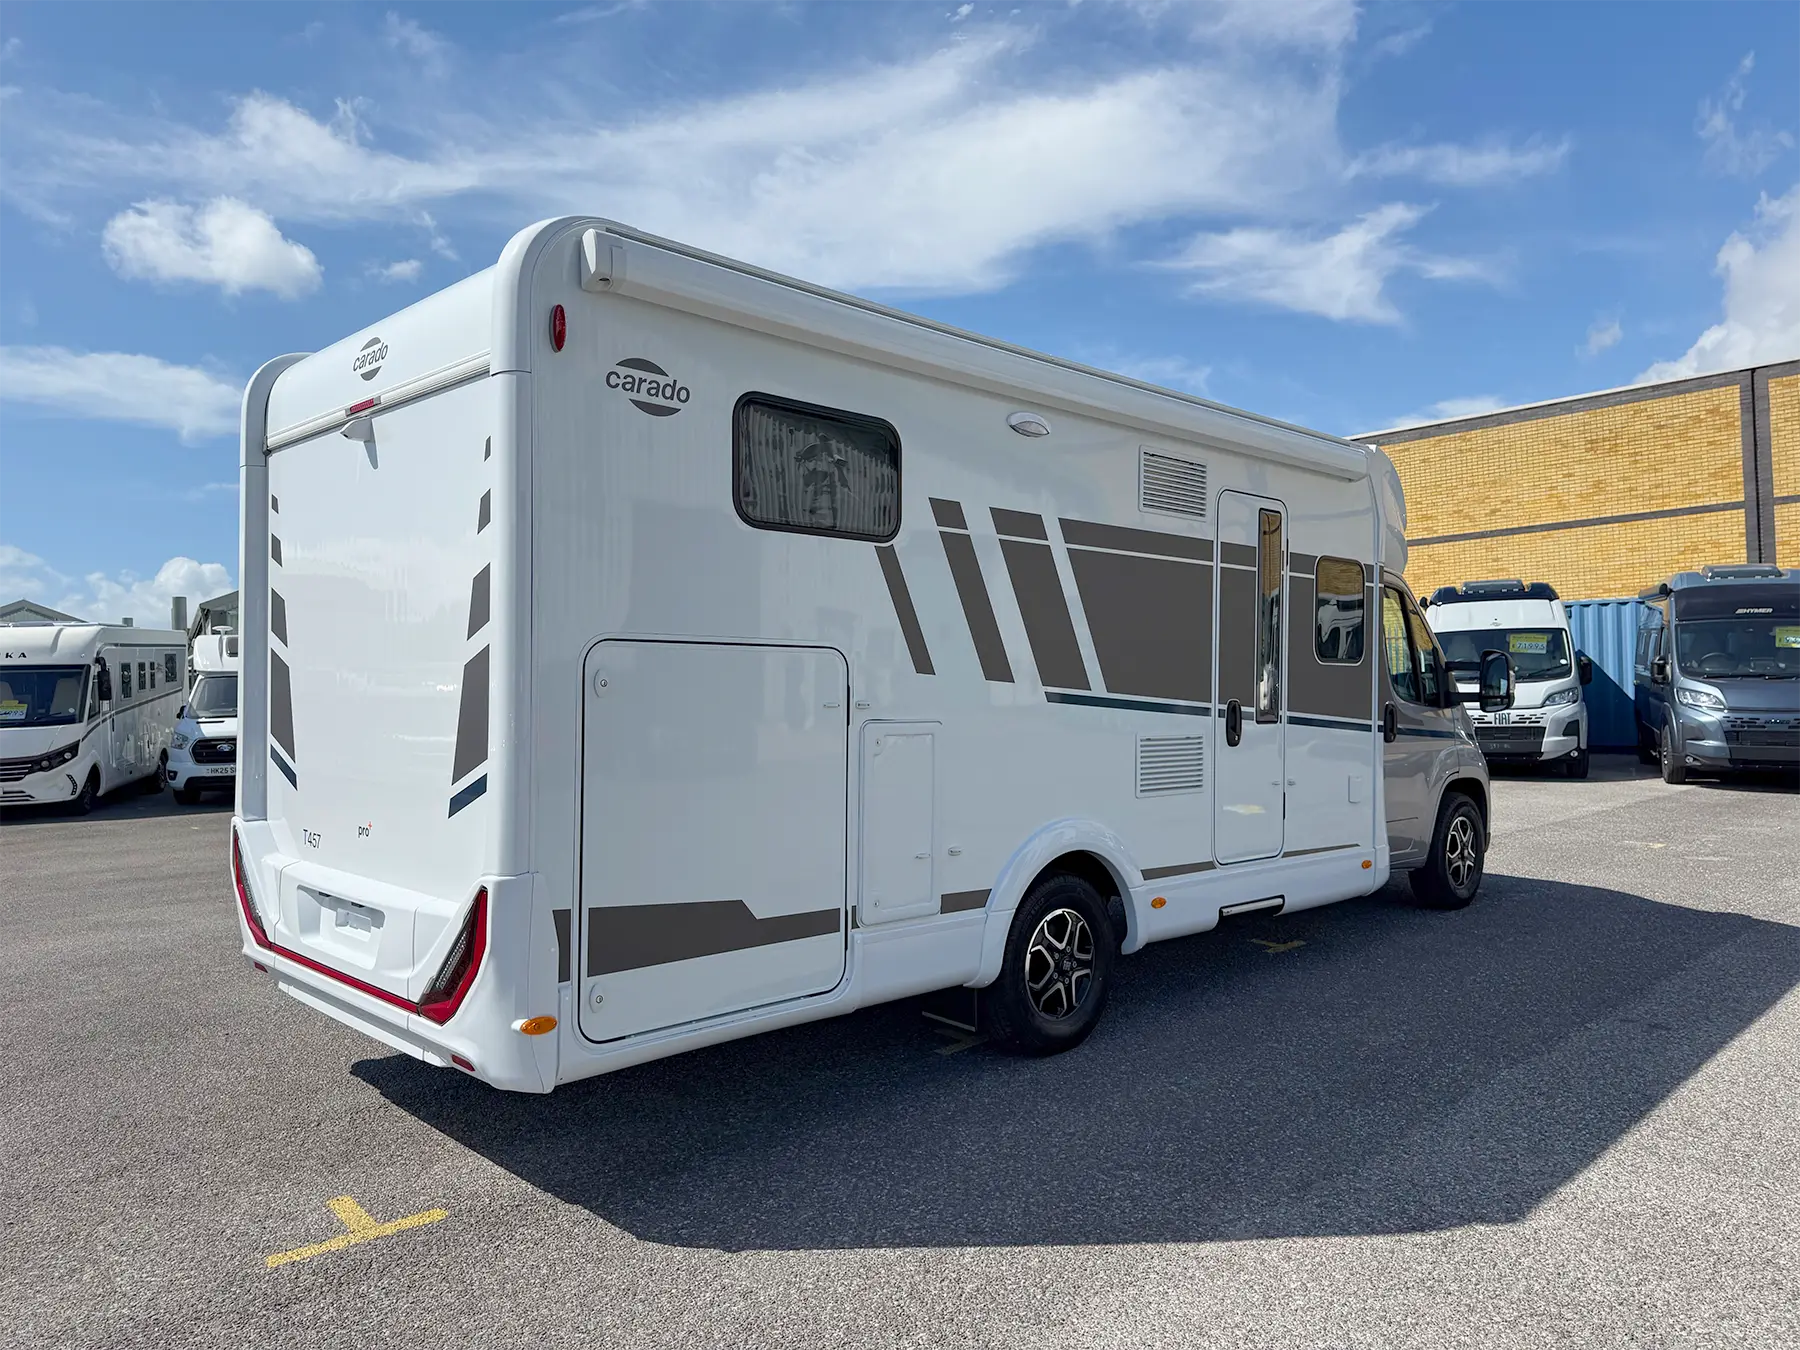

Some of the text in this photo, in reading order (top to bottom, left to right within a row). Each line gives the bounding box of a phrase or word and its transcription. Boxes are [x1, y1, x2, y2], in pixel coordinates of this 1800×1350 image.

[353, 341, 388, 372] carado
[605, 370, 691, 404] carado
[1494, 712, 1511, 725] FIAT
[210, 767, 228, 775] HK25
[303, 828, 321, 849] T457
